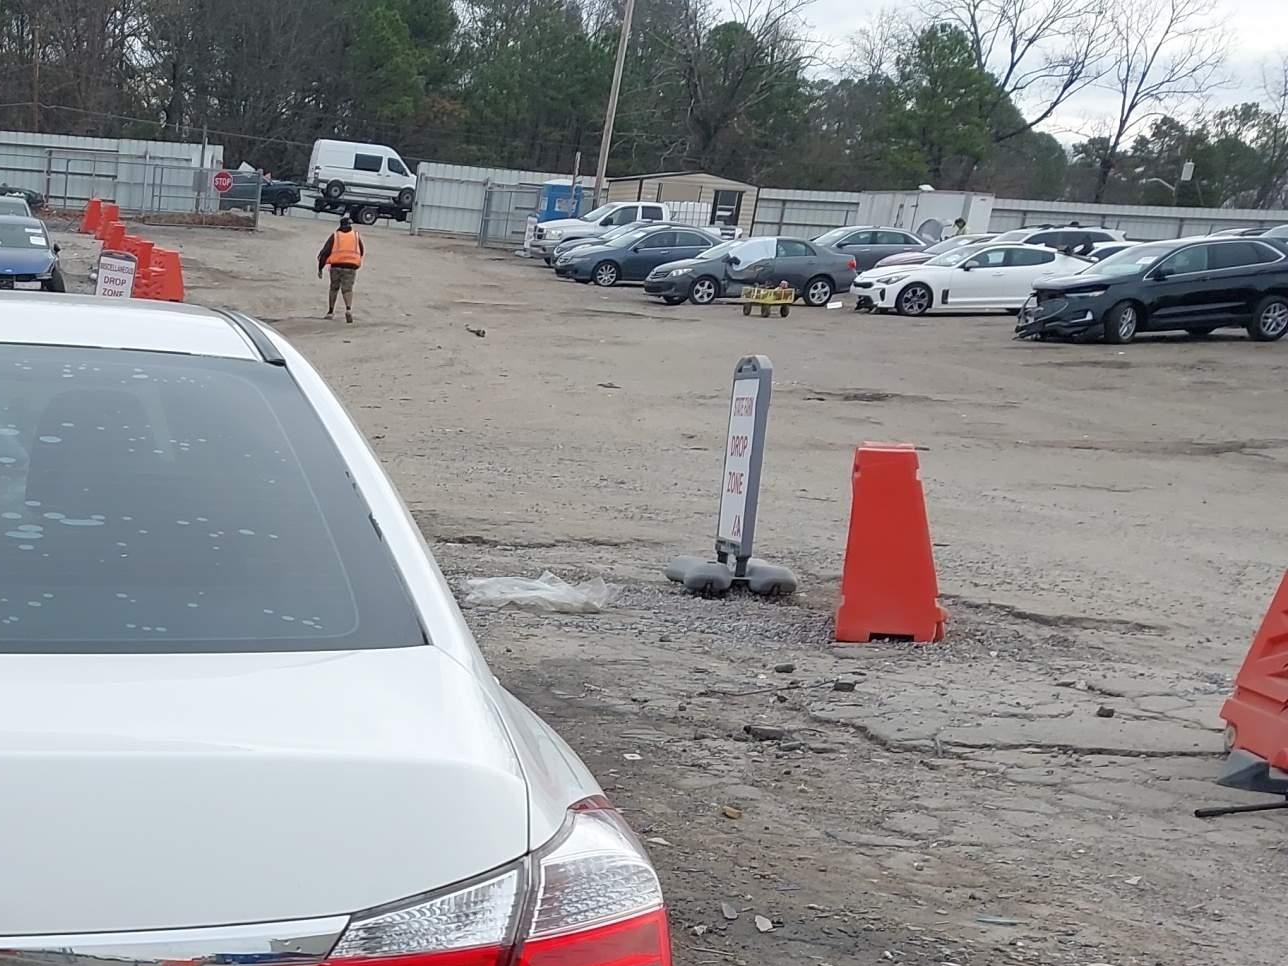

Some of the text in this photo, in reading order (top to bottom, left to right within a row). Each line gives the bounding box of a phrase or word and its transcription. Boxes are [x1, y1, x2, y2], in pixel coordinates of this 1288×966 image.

[215, 177, 232, 186] STOP
[103, 276, 127, 287] DROP
[102, 287, 125, 297] ZONE
[730, 436, 748, 457] DROP
[726, 472, 744, 495] ZONE
